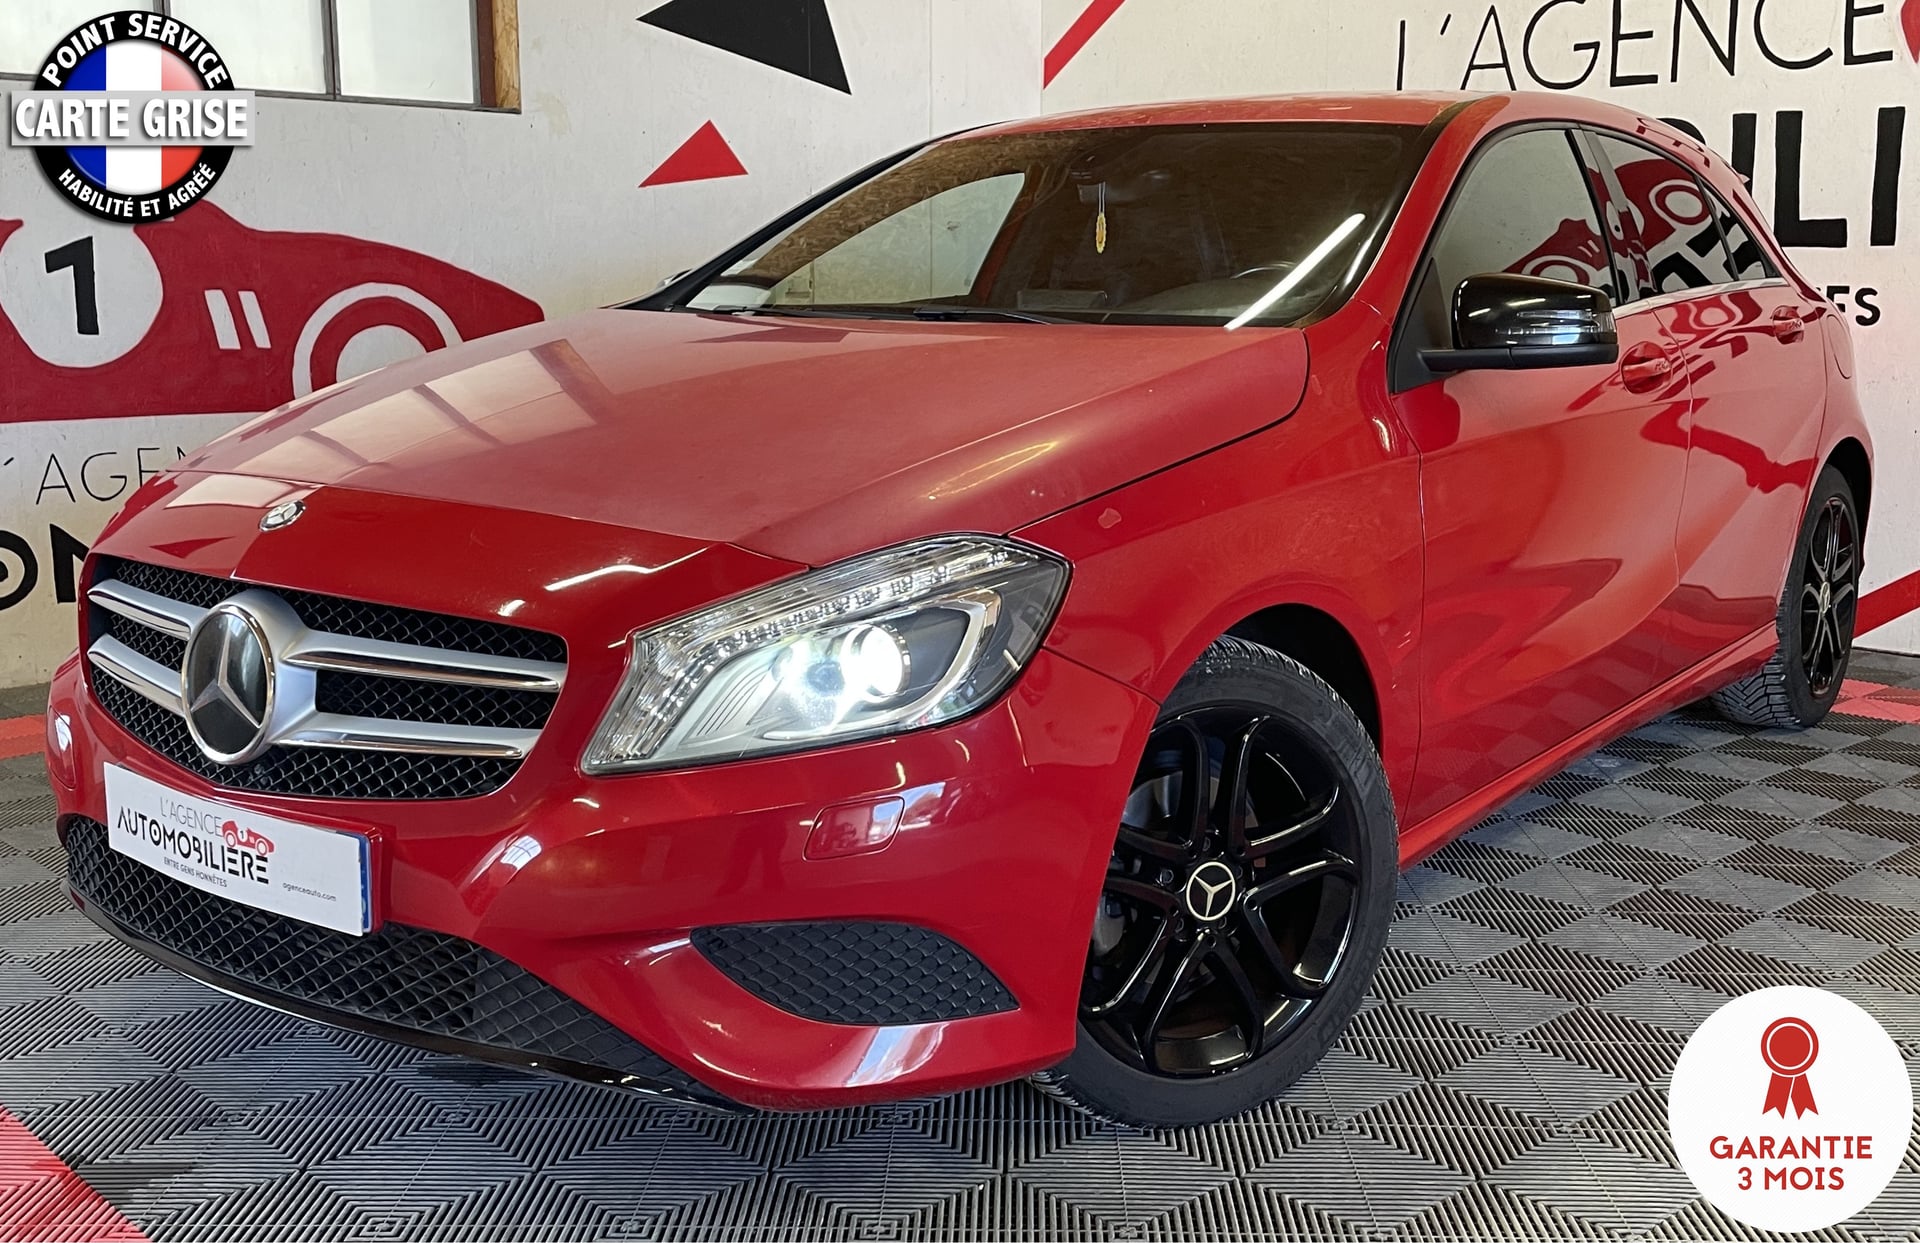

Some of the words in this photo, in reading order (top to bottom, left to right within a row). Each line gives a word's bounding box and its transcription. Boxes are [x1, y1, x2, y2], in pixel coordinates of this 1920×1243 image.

[45, 236, 99, 335] 1
[160, 796, 223, 837] L'AGENCE
[163, 856, 180, 870] ENTRE
[179, 863, 195, 877] GENS
[282, 882, 337, 902] agenceauto.com
